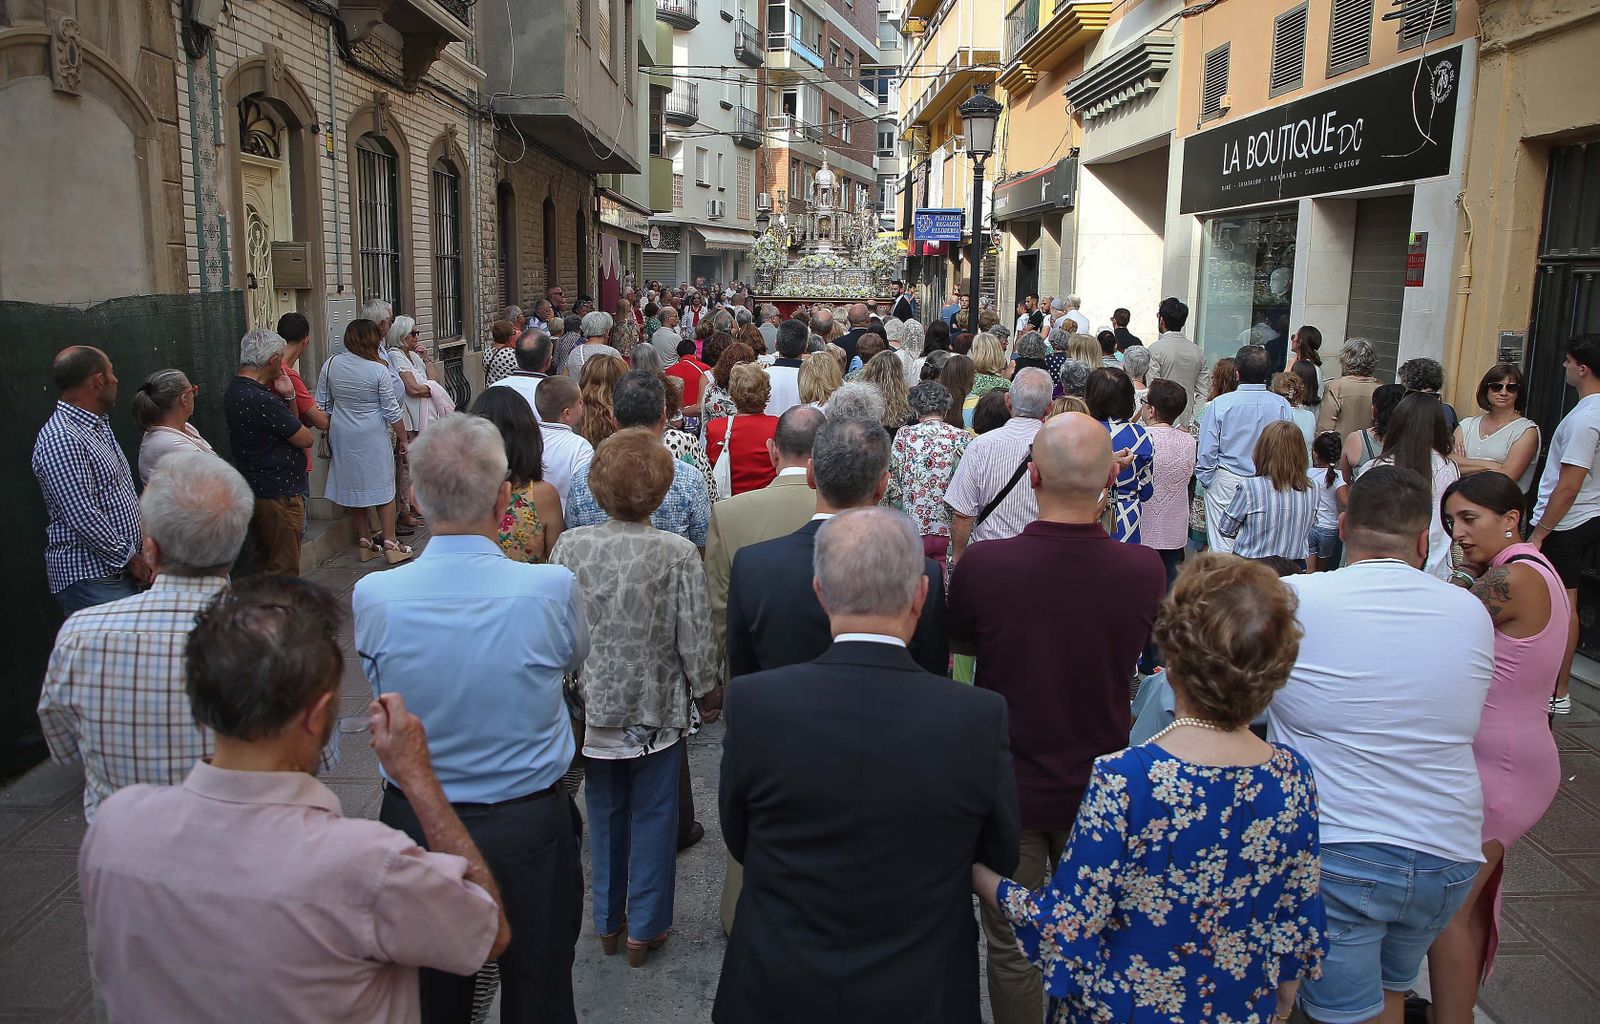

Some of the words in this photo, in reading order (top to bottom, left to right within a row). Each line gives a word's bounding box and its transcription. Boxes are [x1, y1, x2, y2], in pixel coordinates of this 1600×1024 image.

[1222, 139, 1240, 175] LA
[1246, 110, 1337, 170] BOUTIQUE
[1336, 117, 1364, 155] DC
[1304, 165, 1326, 176] CASUAL
[1333, 159, 1361, 170] CUSTOM
